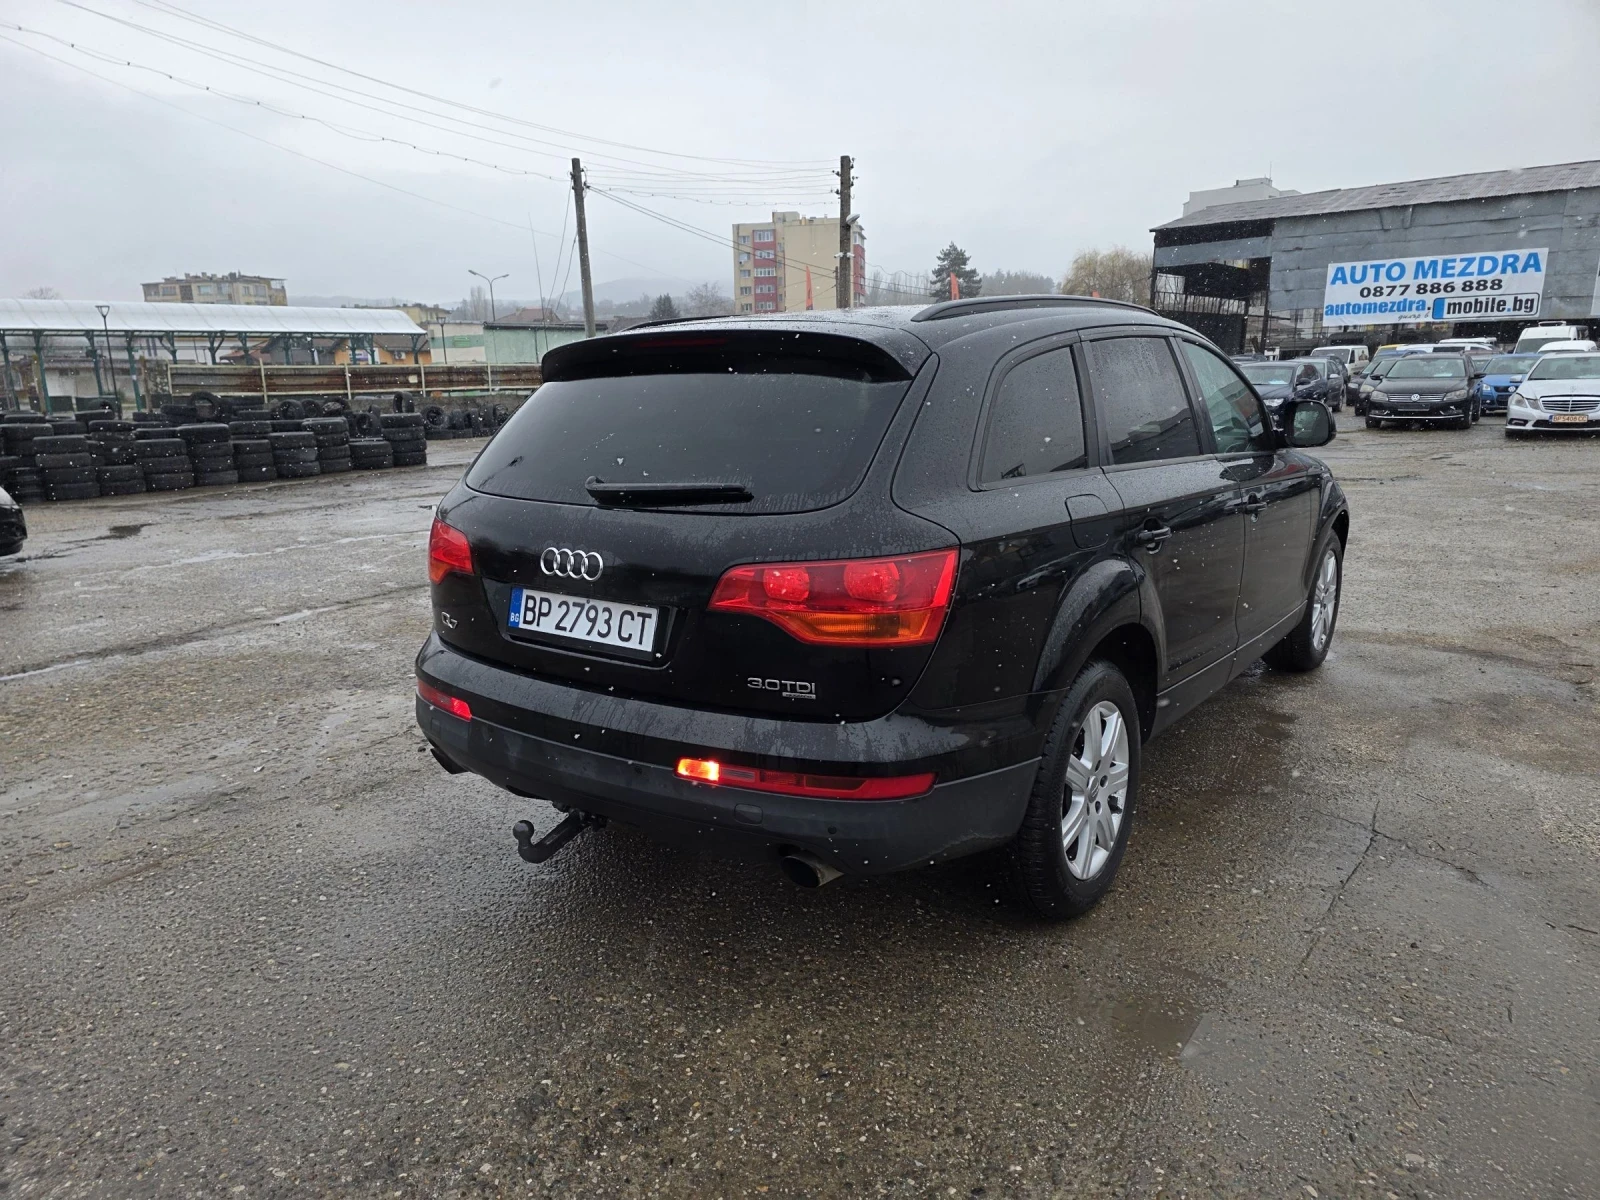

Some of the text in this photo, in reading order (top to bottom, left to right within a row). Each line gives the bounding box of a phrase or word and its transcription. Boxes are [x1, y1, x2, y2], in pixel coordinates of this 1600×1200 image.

[1330, 252, 1542, 286] AUTO MEZDRA
[1359, 278, 1503, 299] 0877 886 888
[1446, 295, 1535, 315] mobile.bg
[510, 612, 520, 623] BG
[522, 594, 653, 645] BP 2793 CT
